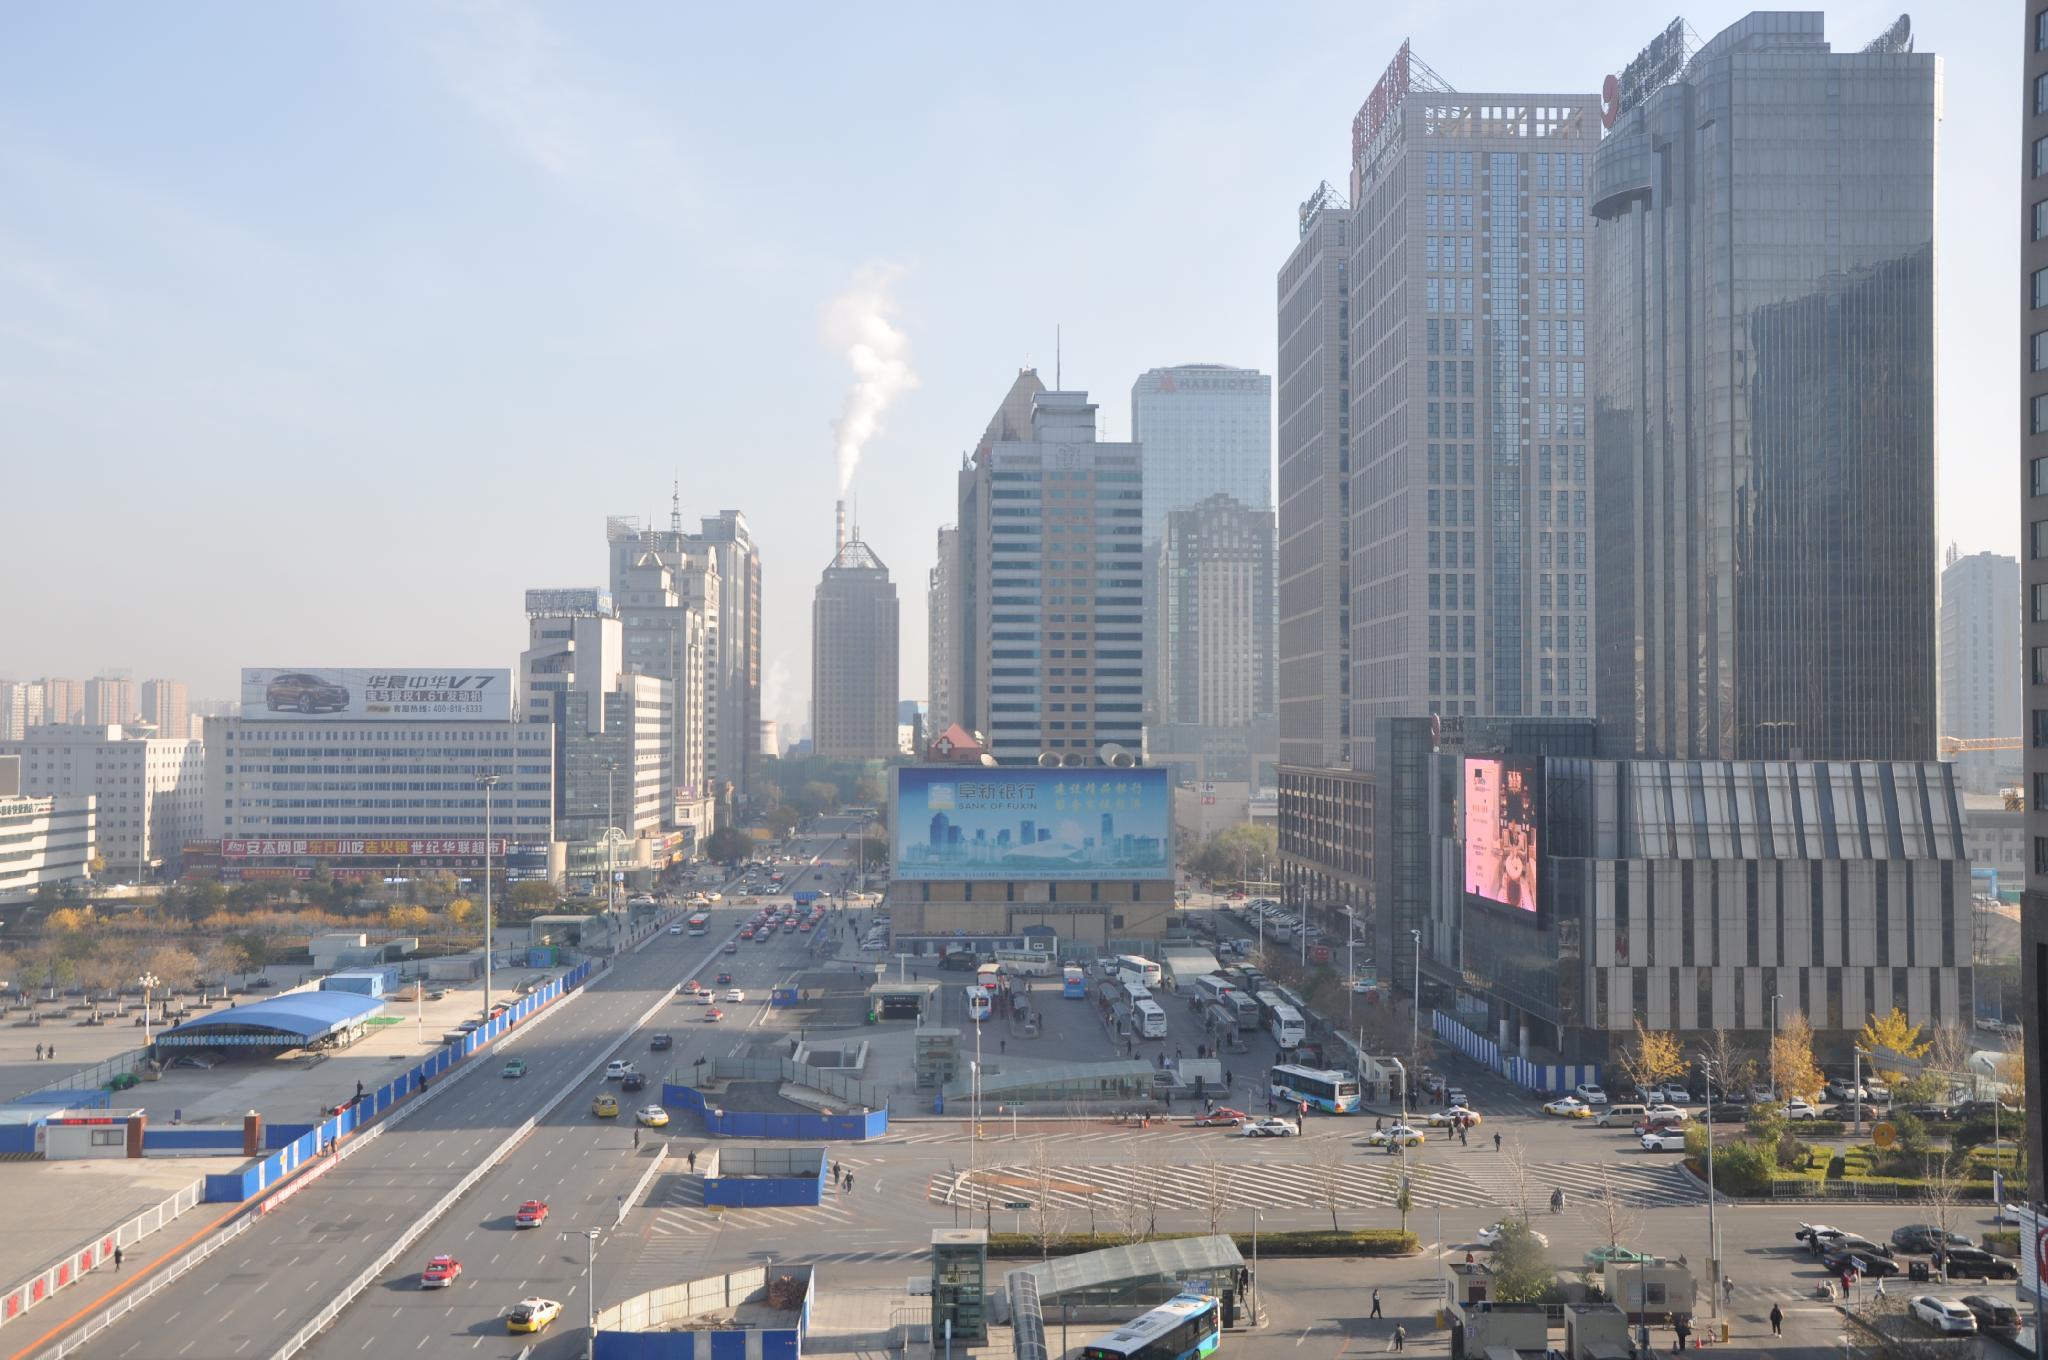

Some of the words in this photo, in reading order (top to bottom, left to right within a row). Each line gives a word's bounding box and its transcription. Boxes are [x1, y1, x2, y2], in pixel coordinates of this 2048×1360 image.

[366, 675, 495, 688] 华晨中华V7
[959, 783, 1036, 799] 阜新银行
